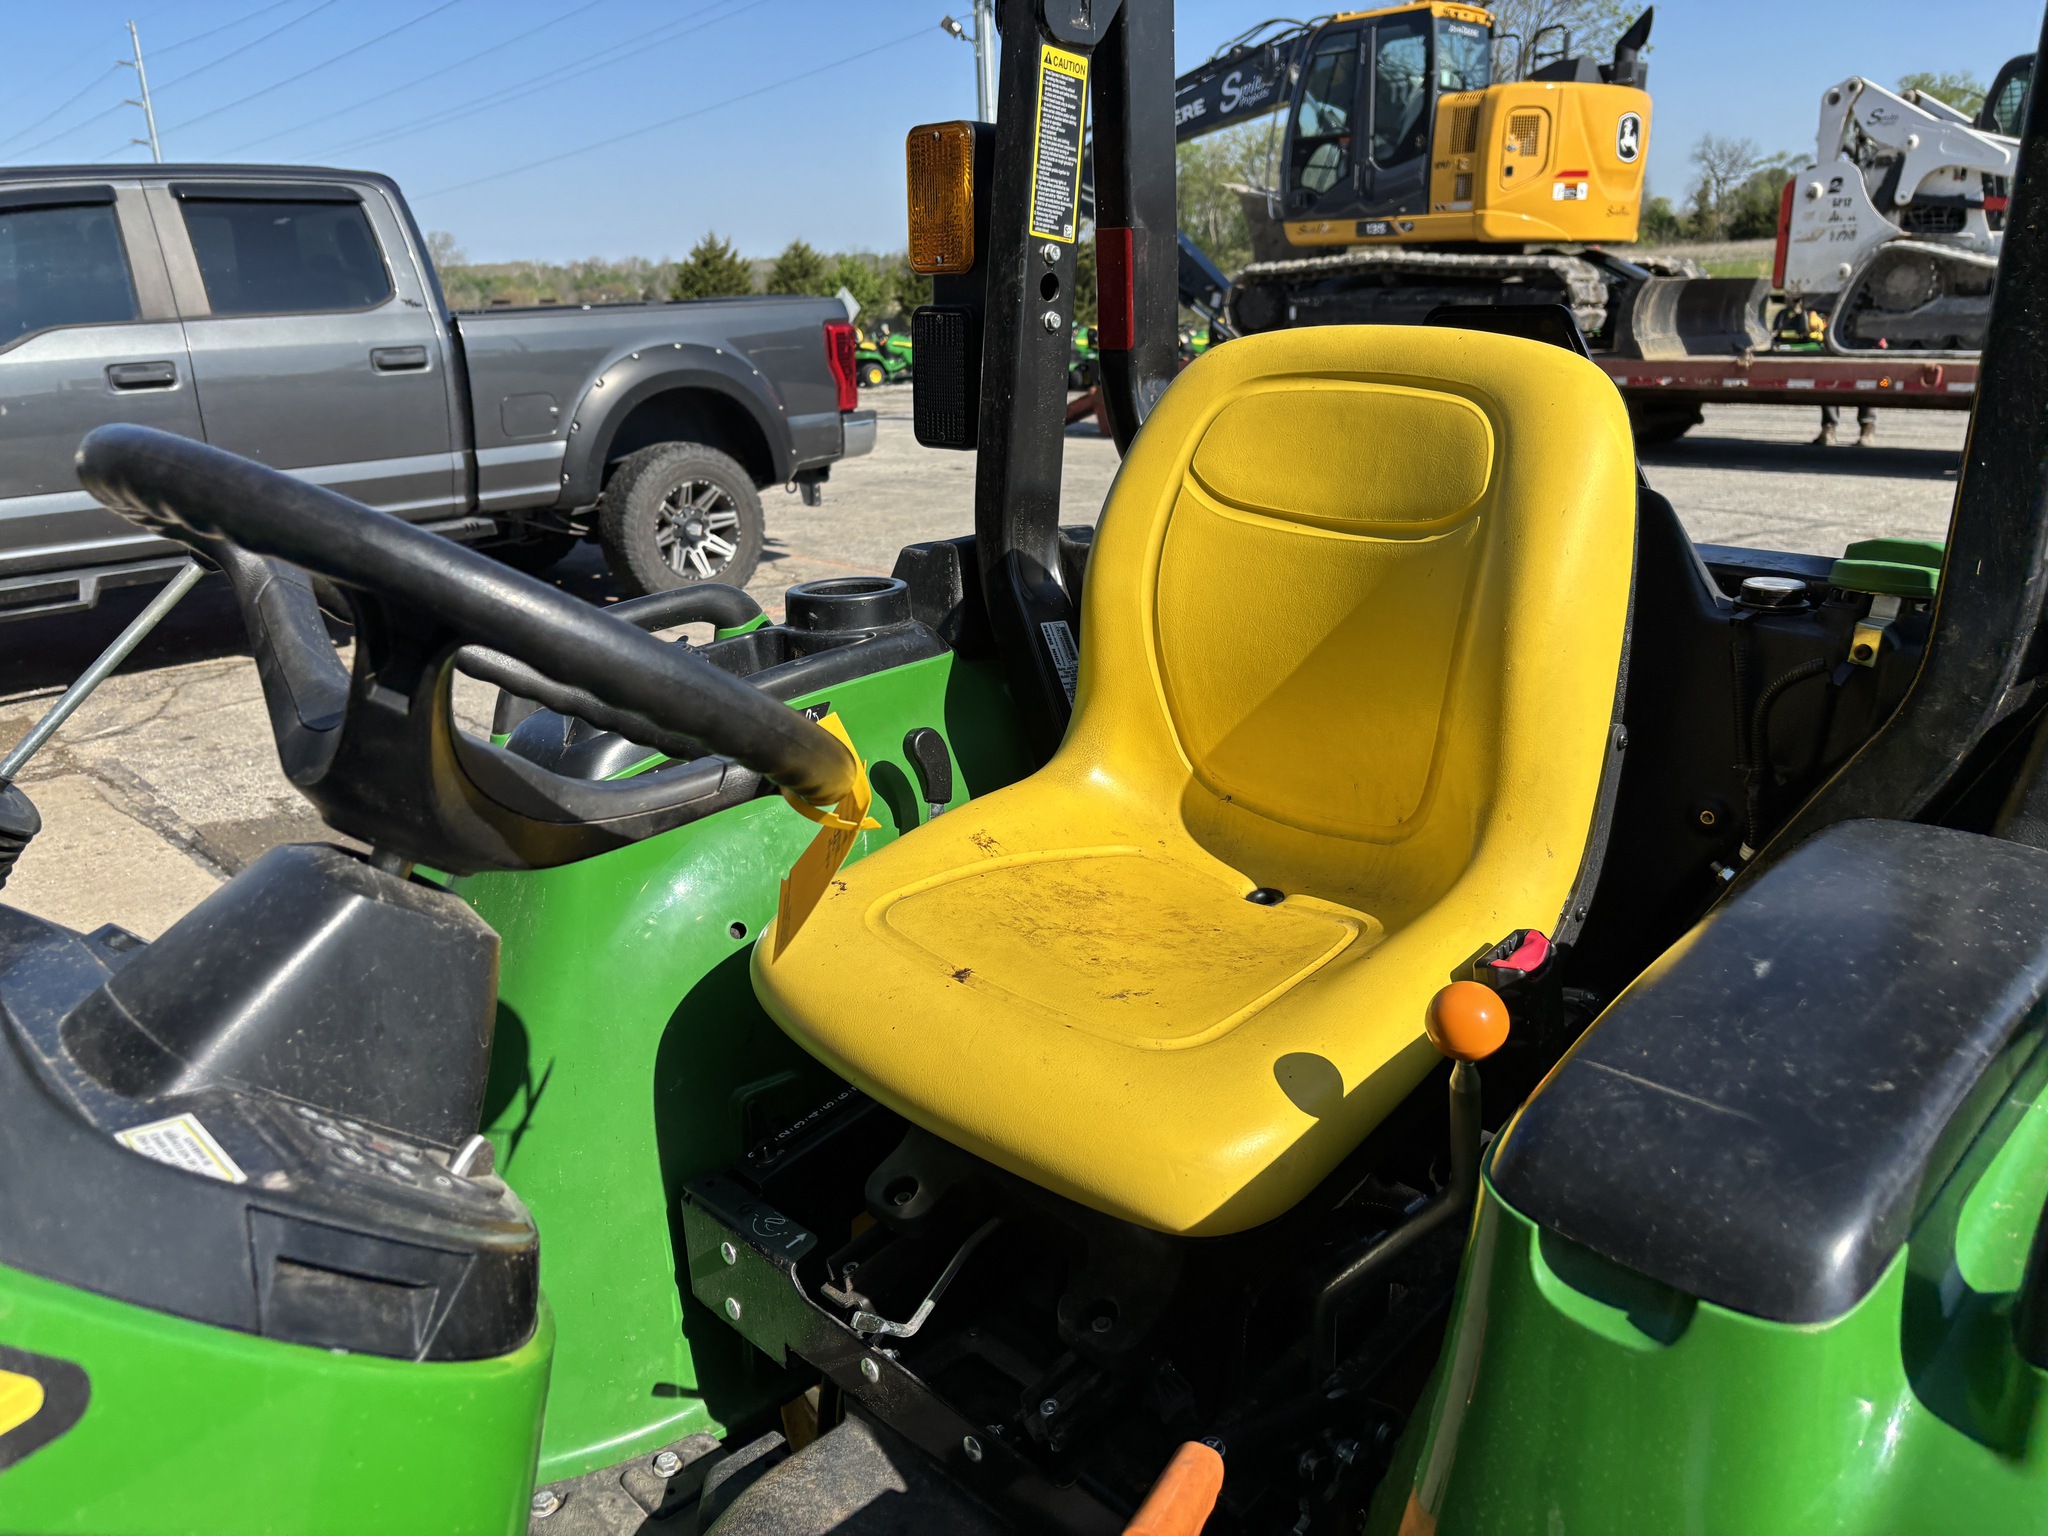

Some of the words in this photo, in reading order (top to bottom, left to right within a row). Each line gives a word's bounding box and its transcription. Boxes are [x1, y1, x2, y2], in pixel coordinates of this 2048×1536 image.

[1053, 55, 1086, 75] CAUTION
[1174, 97, 1206, 126] ERE
[1828, 176, 1843, 193] 2
